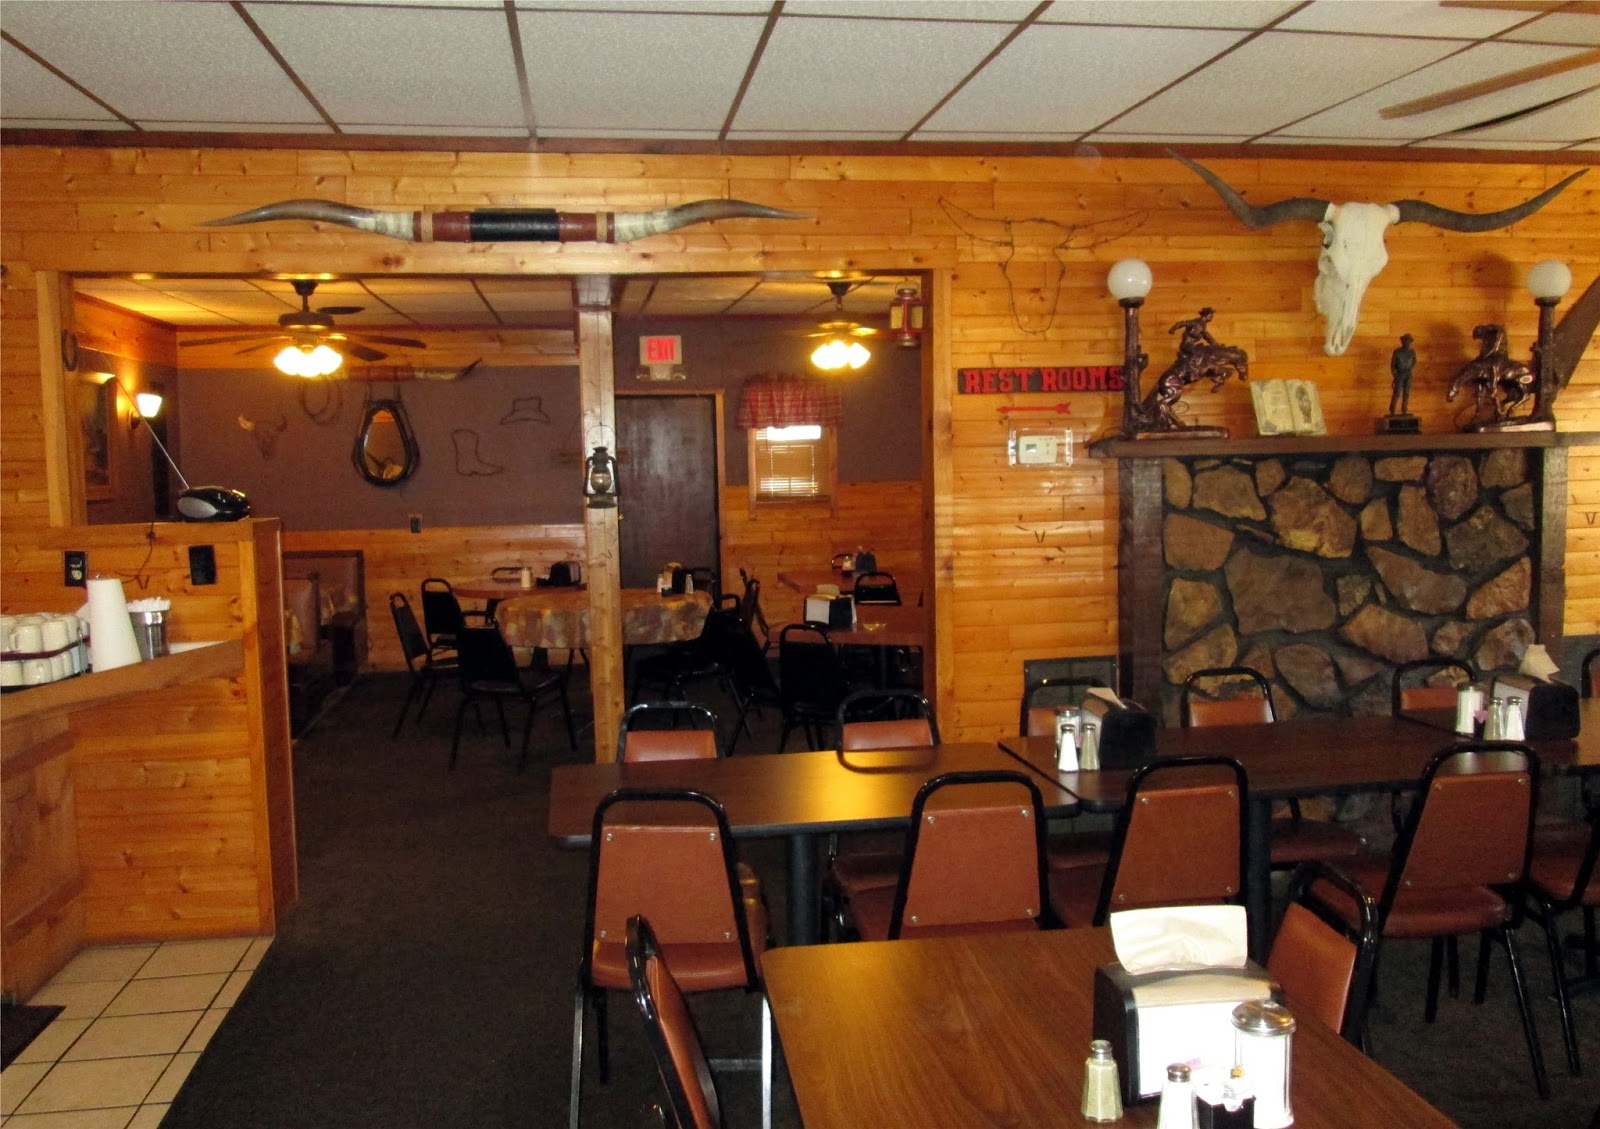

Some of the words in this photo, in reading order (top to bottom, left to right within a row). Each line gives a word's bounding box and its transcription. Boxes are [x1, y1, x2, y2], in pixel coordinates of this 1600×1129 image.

[647, 338, 675, 361] EXIT
[964, 369, 1034, 393] REST
[1040, 366, 1123, 391] ROOMS
